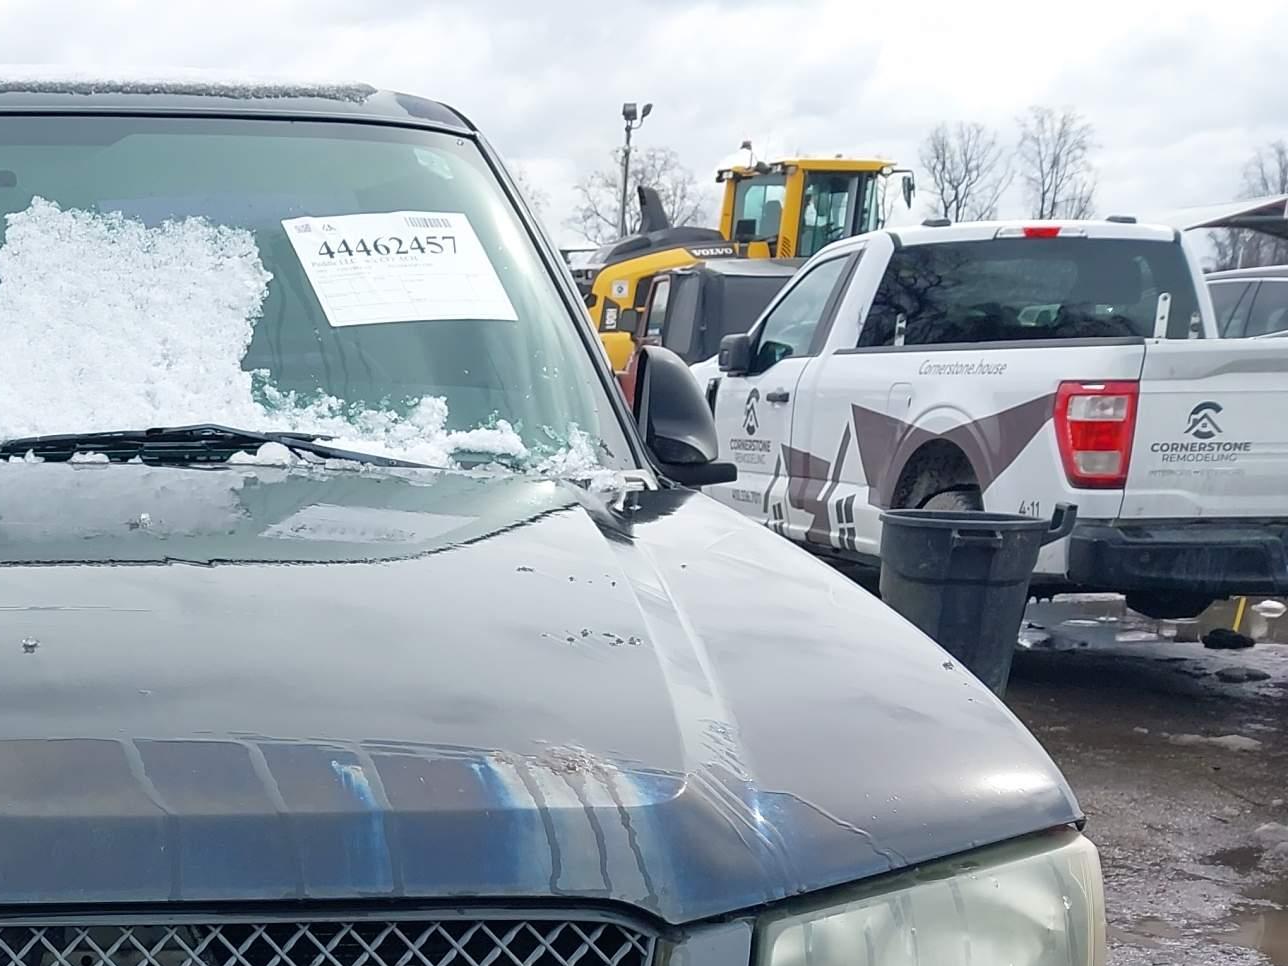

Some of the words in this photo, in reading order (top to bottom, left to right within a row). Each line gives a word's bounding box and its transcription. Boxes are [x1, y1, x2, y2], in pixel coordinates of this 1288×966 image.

[318, 236, 457, 259] 44462457
[691, 247, 733, 256] VOLVO
[918, 358, 1008, 376] Cornerstone.house
[1150, 442, 1253, 453] CORNERSTONE
[1161, 453, 1238, 463] REMODELING
